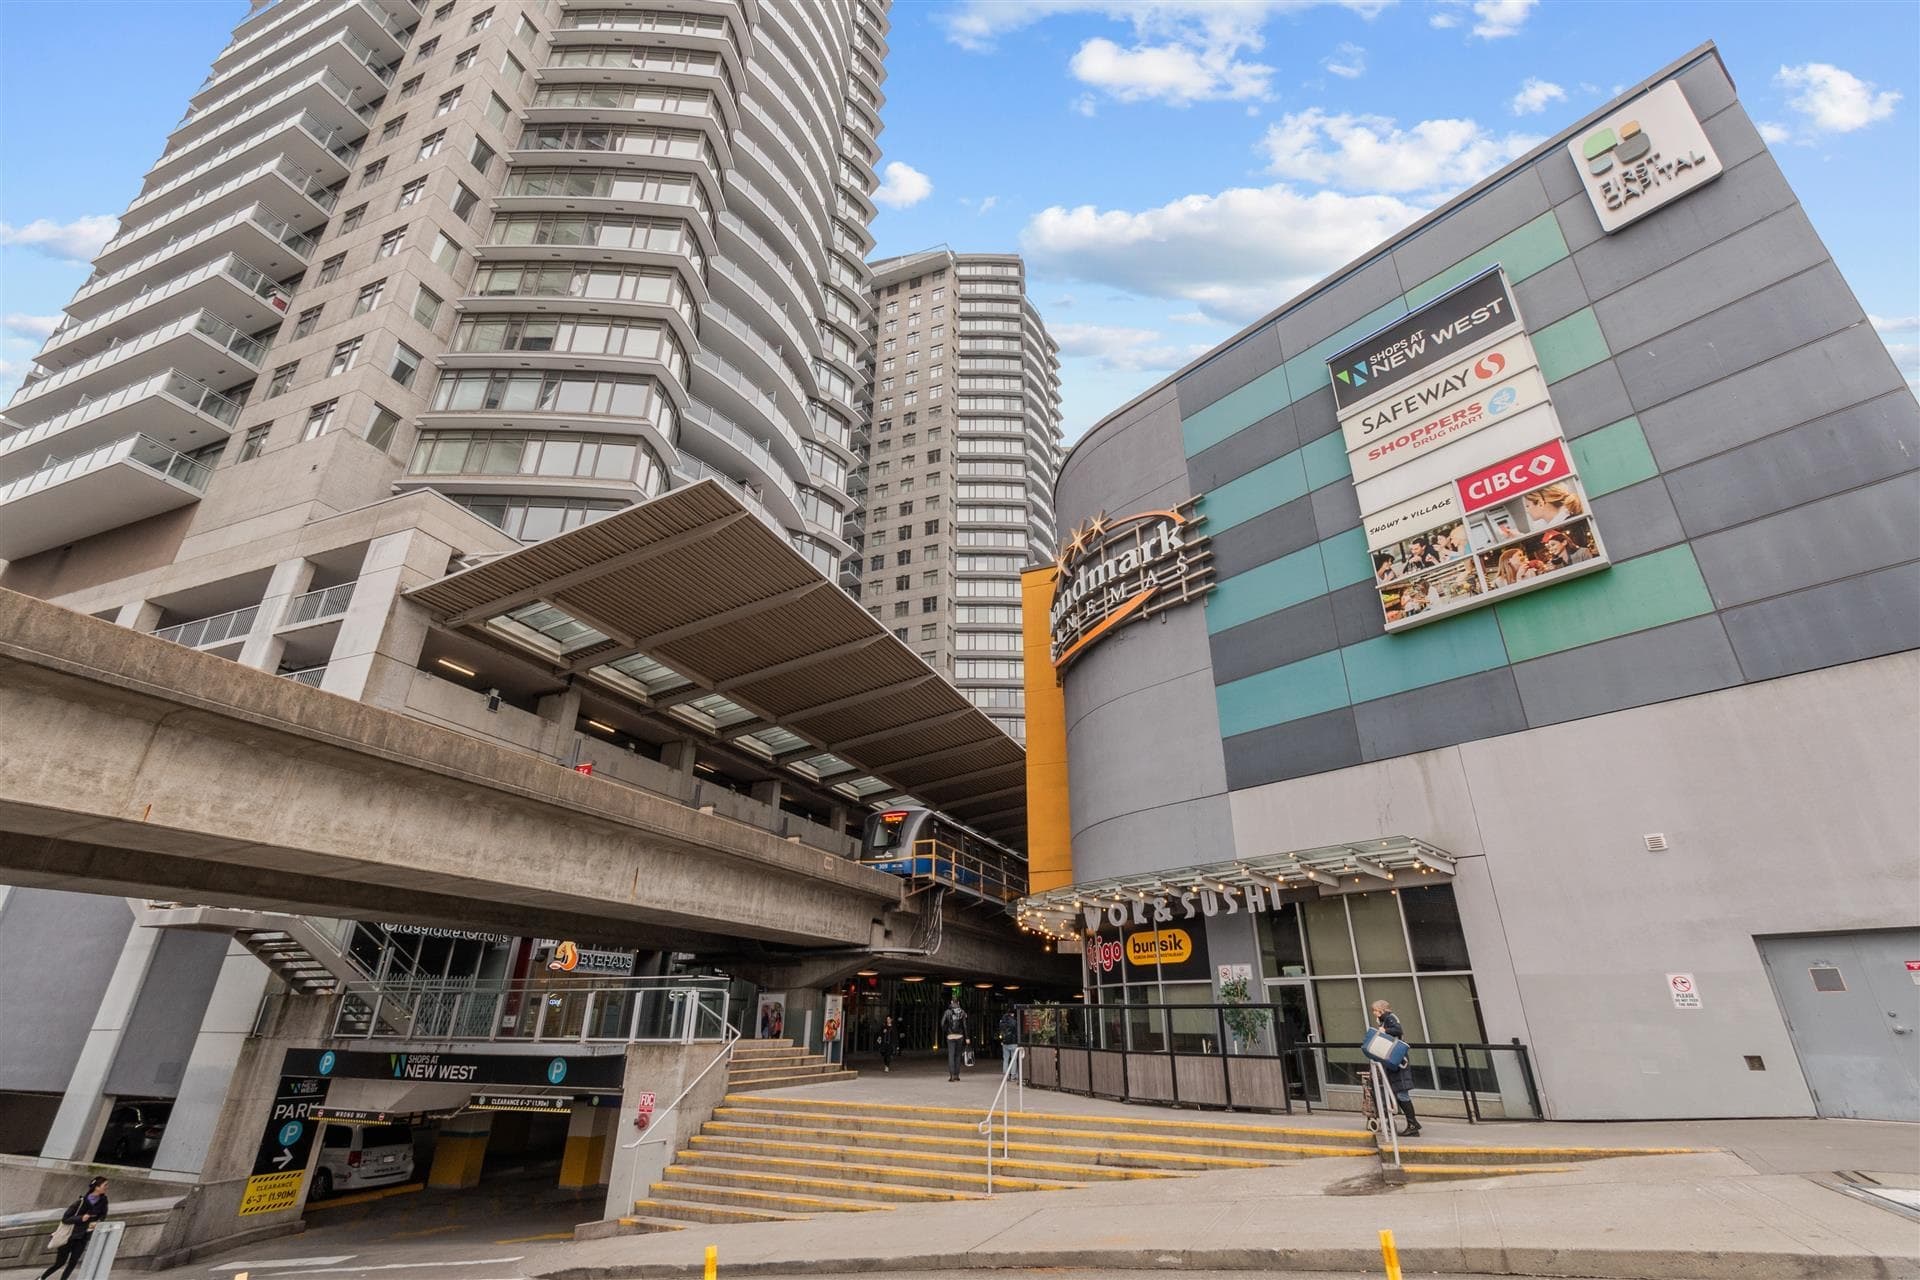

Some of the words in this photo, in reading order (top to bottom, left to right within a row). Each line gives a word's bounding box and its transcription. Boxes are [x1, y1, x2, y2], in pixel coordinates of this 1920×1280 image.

[1600, 152, 1661, 200] FIRST
[1606, 150, 1706, 210] CAPITAL
[1369, 339, 1408, 364] SHOPS
[1410, 329, 1425, 345] AT
[1371, 338, 1426, 378] NEW
[1430, 297, 1503, 345] WEST
[1362, 368, 1470, 434] SAFEWAY
[1368, 402, 1483, 461] SHOPPERS
[1413, 429, 1446, 449] DRUG
[1449, 414, 1483, 433] MART
[1468, 464, 1528, 500] CIBC
[1410, 498, 1452, 520] VILLAGE
[1153, 896, 1174, 923] &
[1181, 883, 1282, 920] SUSHI
[1132, 933, 1184, 954] bunsik
[404, 1064, 439, 1078] NEW
[438, 1065, 477, 1080] WEST
[407, 1055, 429, 1064] SHOPS
[430, 1055, 439, 1064] AT
[491, 1098, 520, 1106] CLEARANCE
[256, 1181, 293, 1192] CLEARANCE
